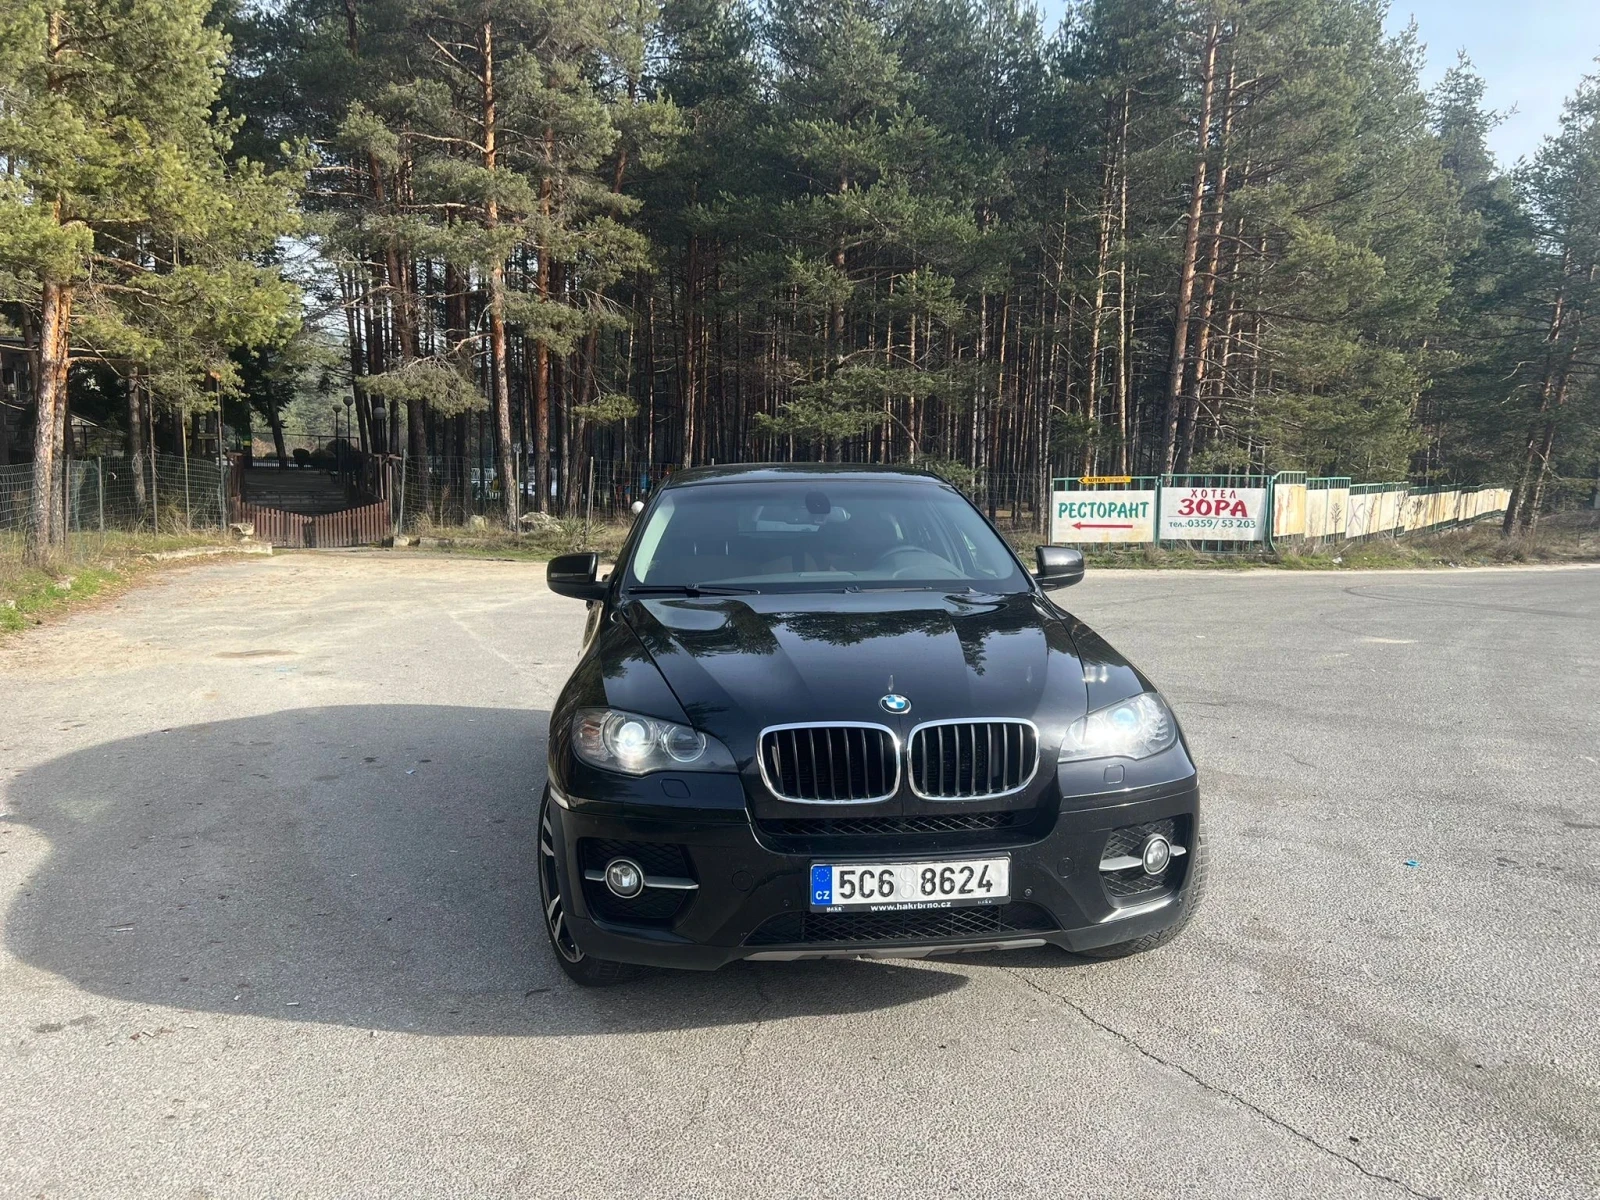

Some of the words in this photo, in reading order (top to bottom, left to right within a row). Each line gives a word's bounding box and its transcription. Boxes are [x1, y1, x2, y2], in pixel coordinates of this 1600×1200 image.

[1190, 489, 1236, 499] ХОТЕЛ
[1058, 501, 1150, 519] РЕСТОРАНТ
[1178, 498, 1248, 518] ЗОРА
[1221, 519, 1234, 528] 53
[1236, 519, 1256, 529] 203
[839, 869, 895, 899] 5C6
[920, 864, 993, 896] 8624
[815, 890, 830, 900] CZ
[870, 901, 952, 911] www.hakrbrno.cz
